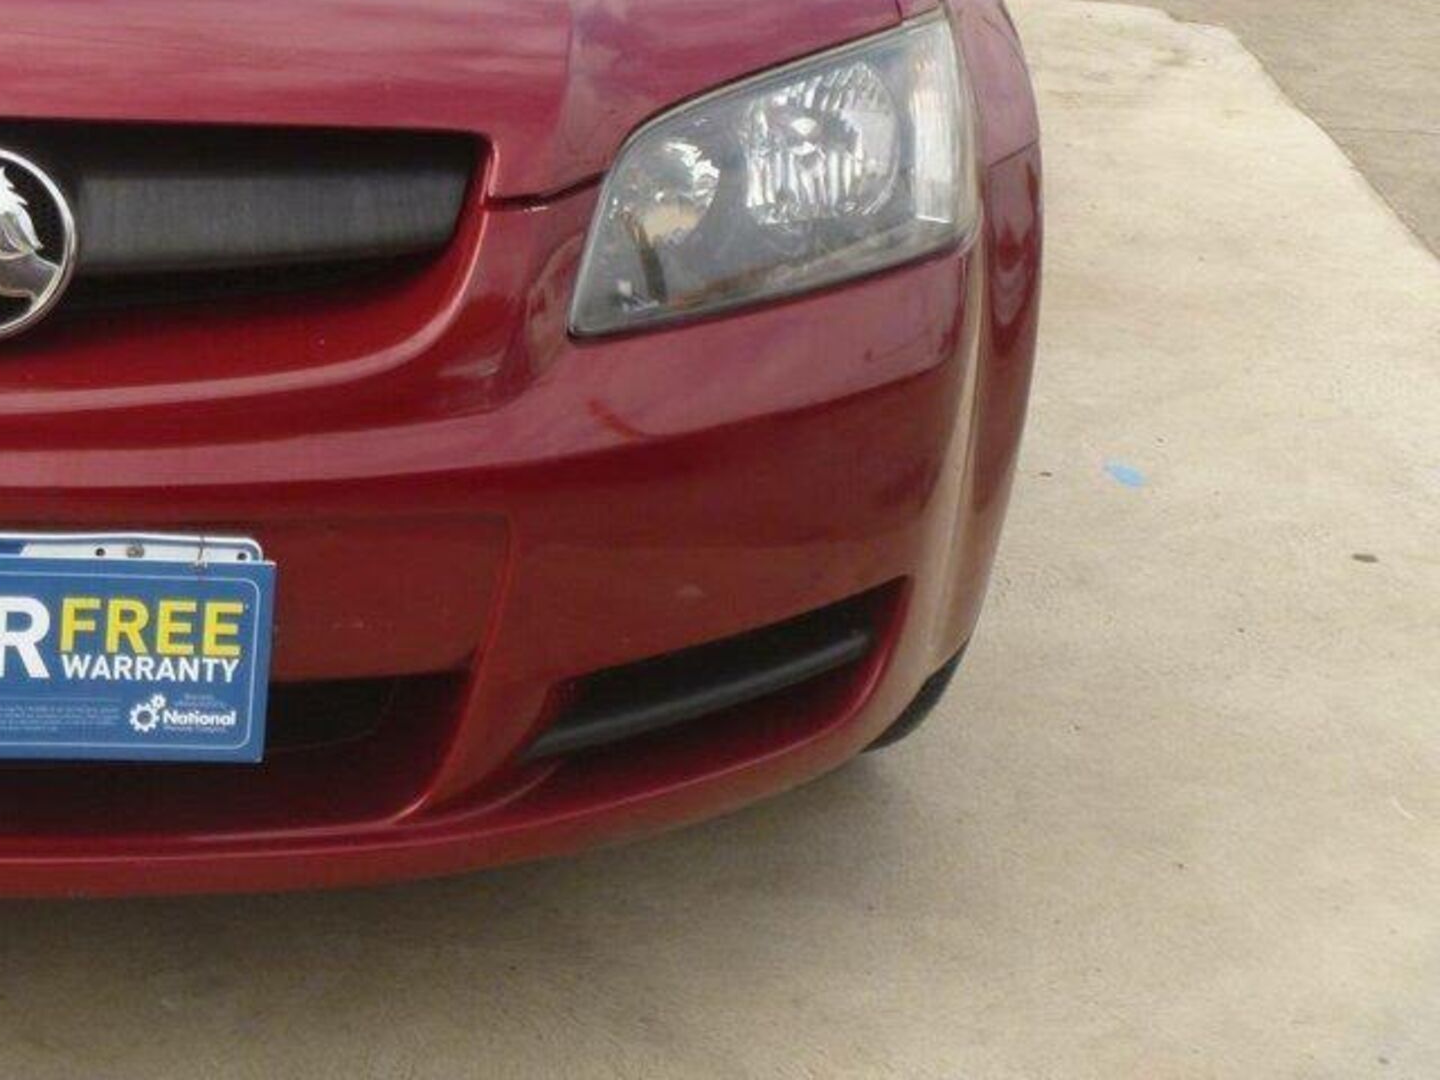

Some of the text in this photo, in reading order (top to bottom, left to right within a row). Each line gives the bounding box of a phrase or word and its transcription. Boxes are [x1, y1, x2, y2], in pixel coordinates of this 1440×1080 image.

[60, 596, 244, 657] FREE
[60, 653, 240, 684] WARRANTY
[162, 708, 237, 726] National
